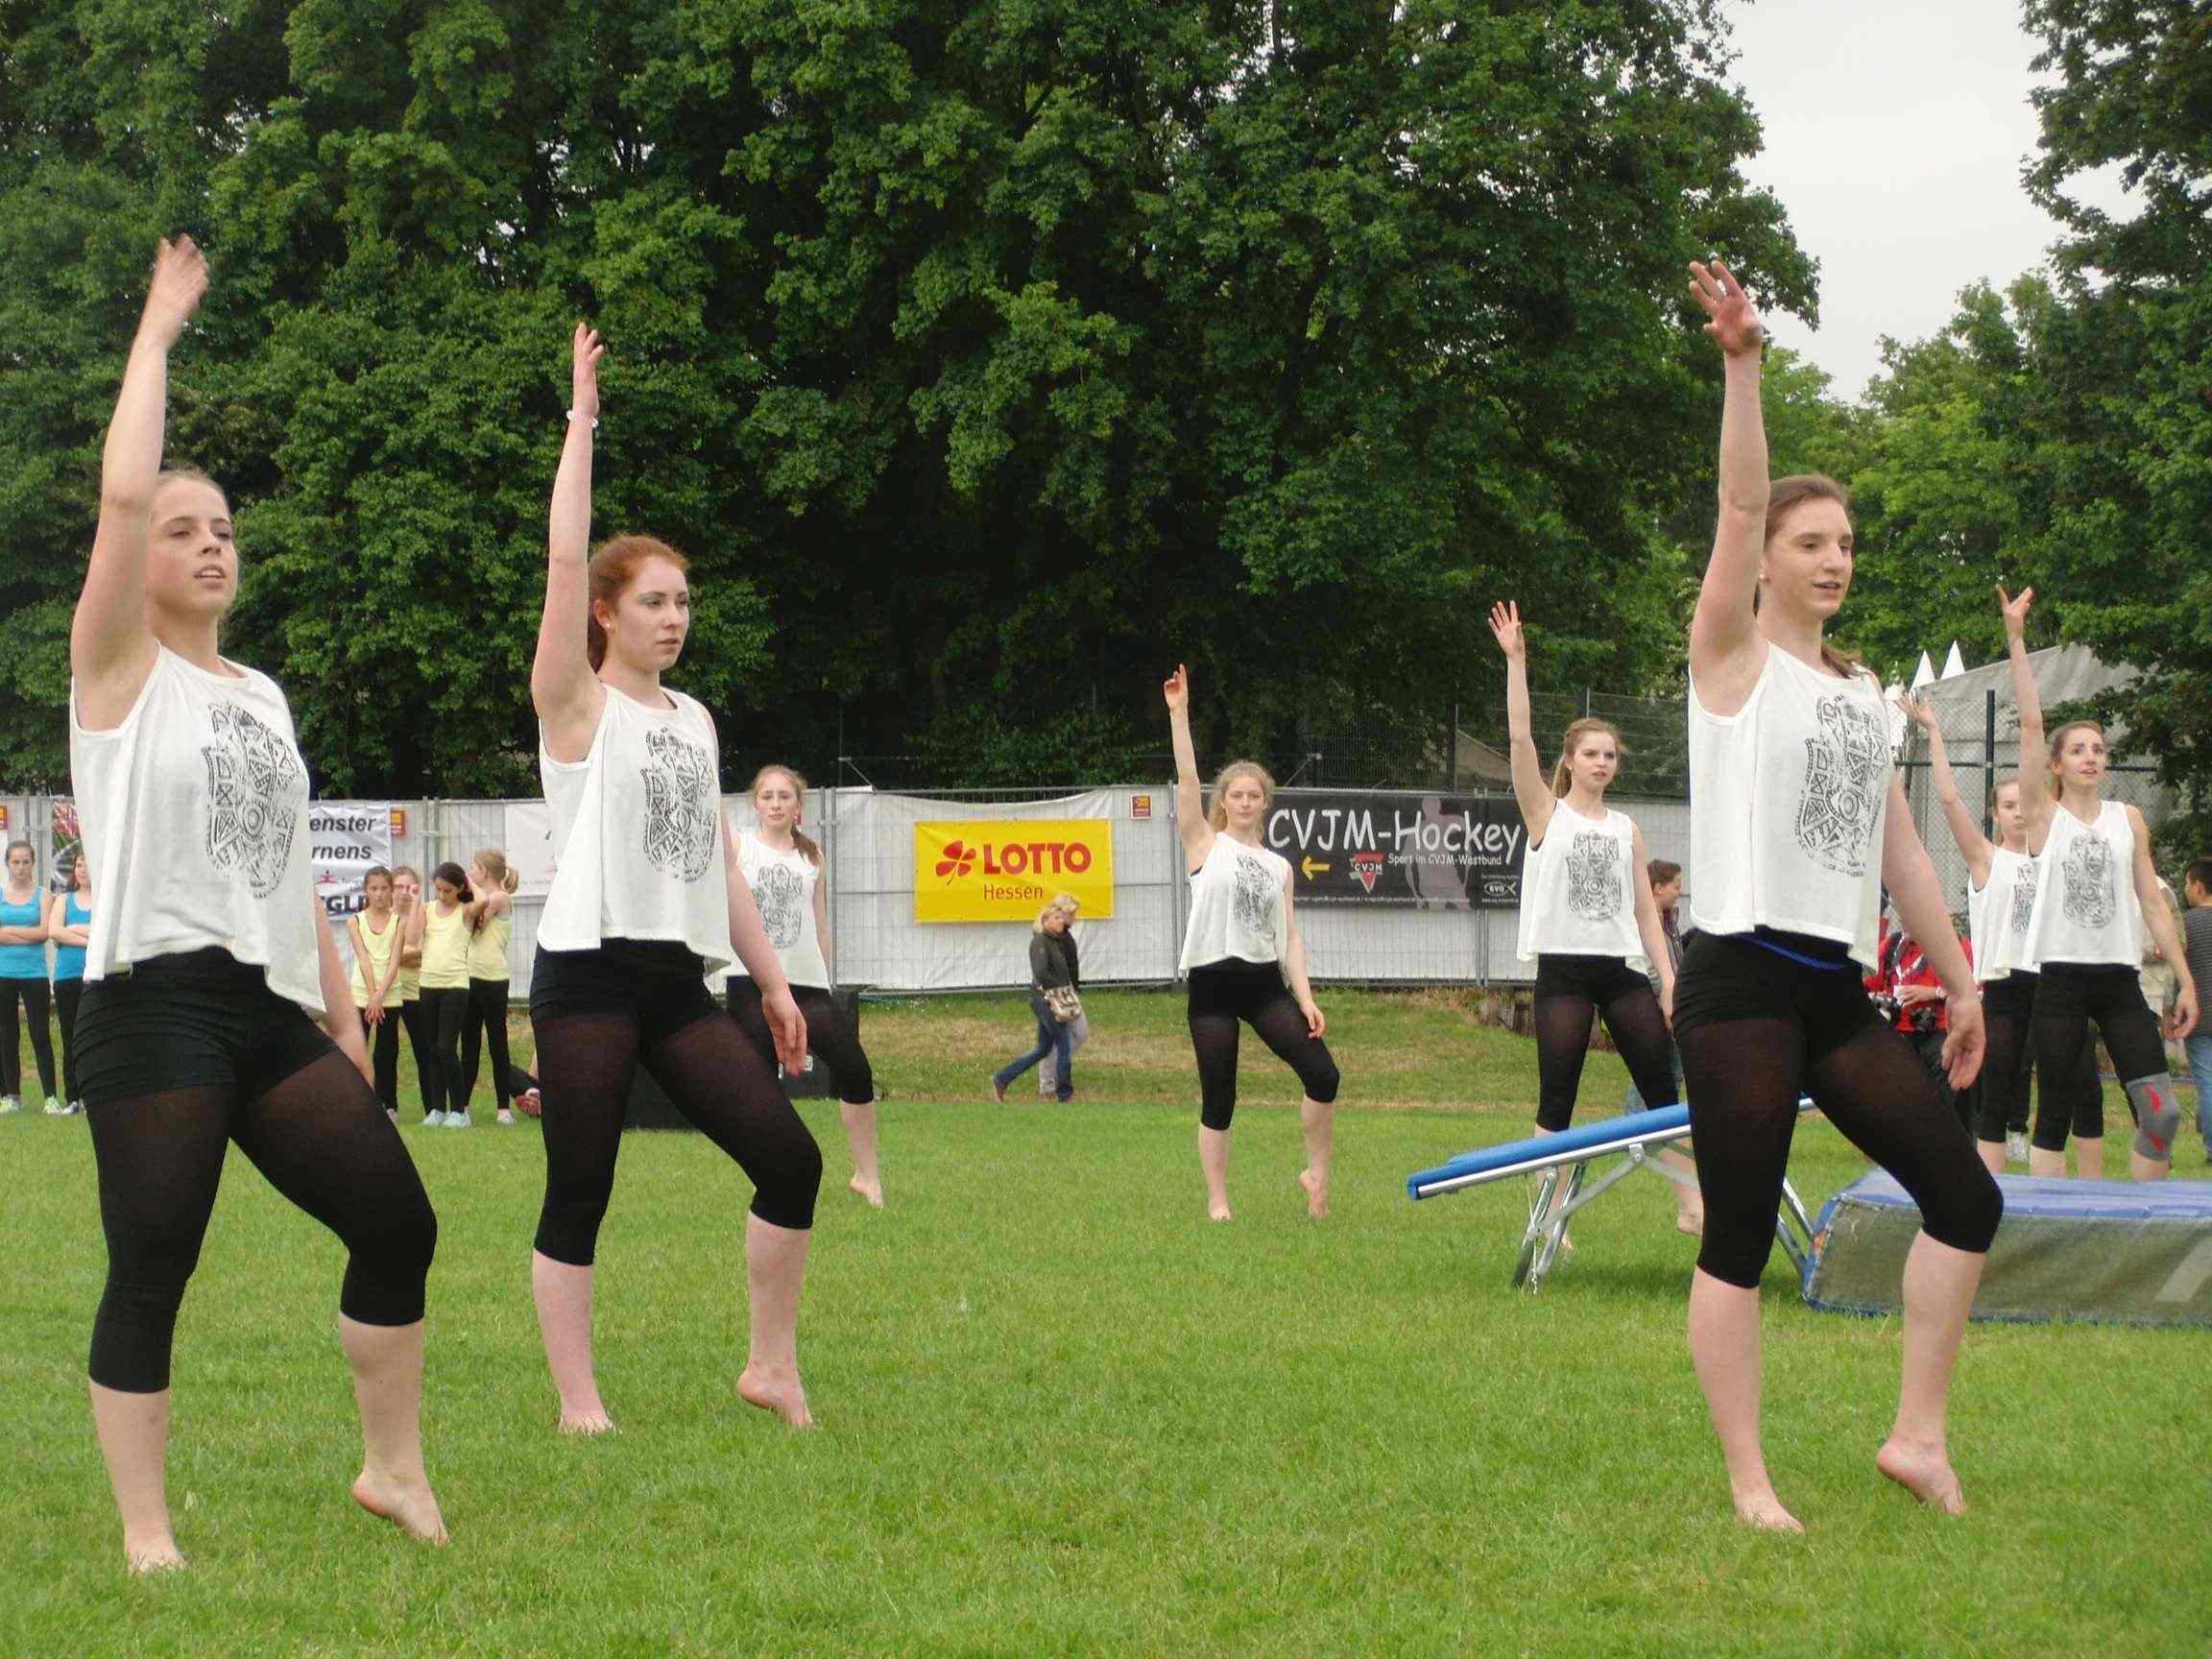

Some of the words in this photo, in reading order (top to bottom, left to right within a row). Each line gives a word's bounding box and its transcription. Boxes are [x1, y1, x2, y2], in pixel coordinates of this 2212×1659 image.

[308, 814, 376, 832] enster
[1268, 808, 1522, 864] CVJM-Hockey
[312, 845, 373, 859] rnens
[983, 843, 1092, 875] LOTTO
[1388, 853, 1414, 867] Sport
[1417, 854, 1426, 865] im
[1428, 854, 1503, 866] CVJM-Westbund
[1354, 863, 1382, 873] CVJM
[983, 883, 1044, 900] Hessen
